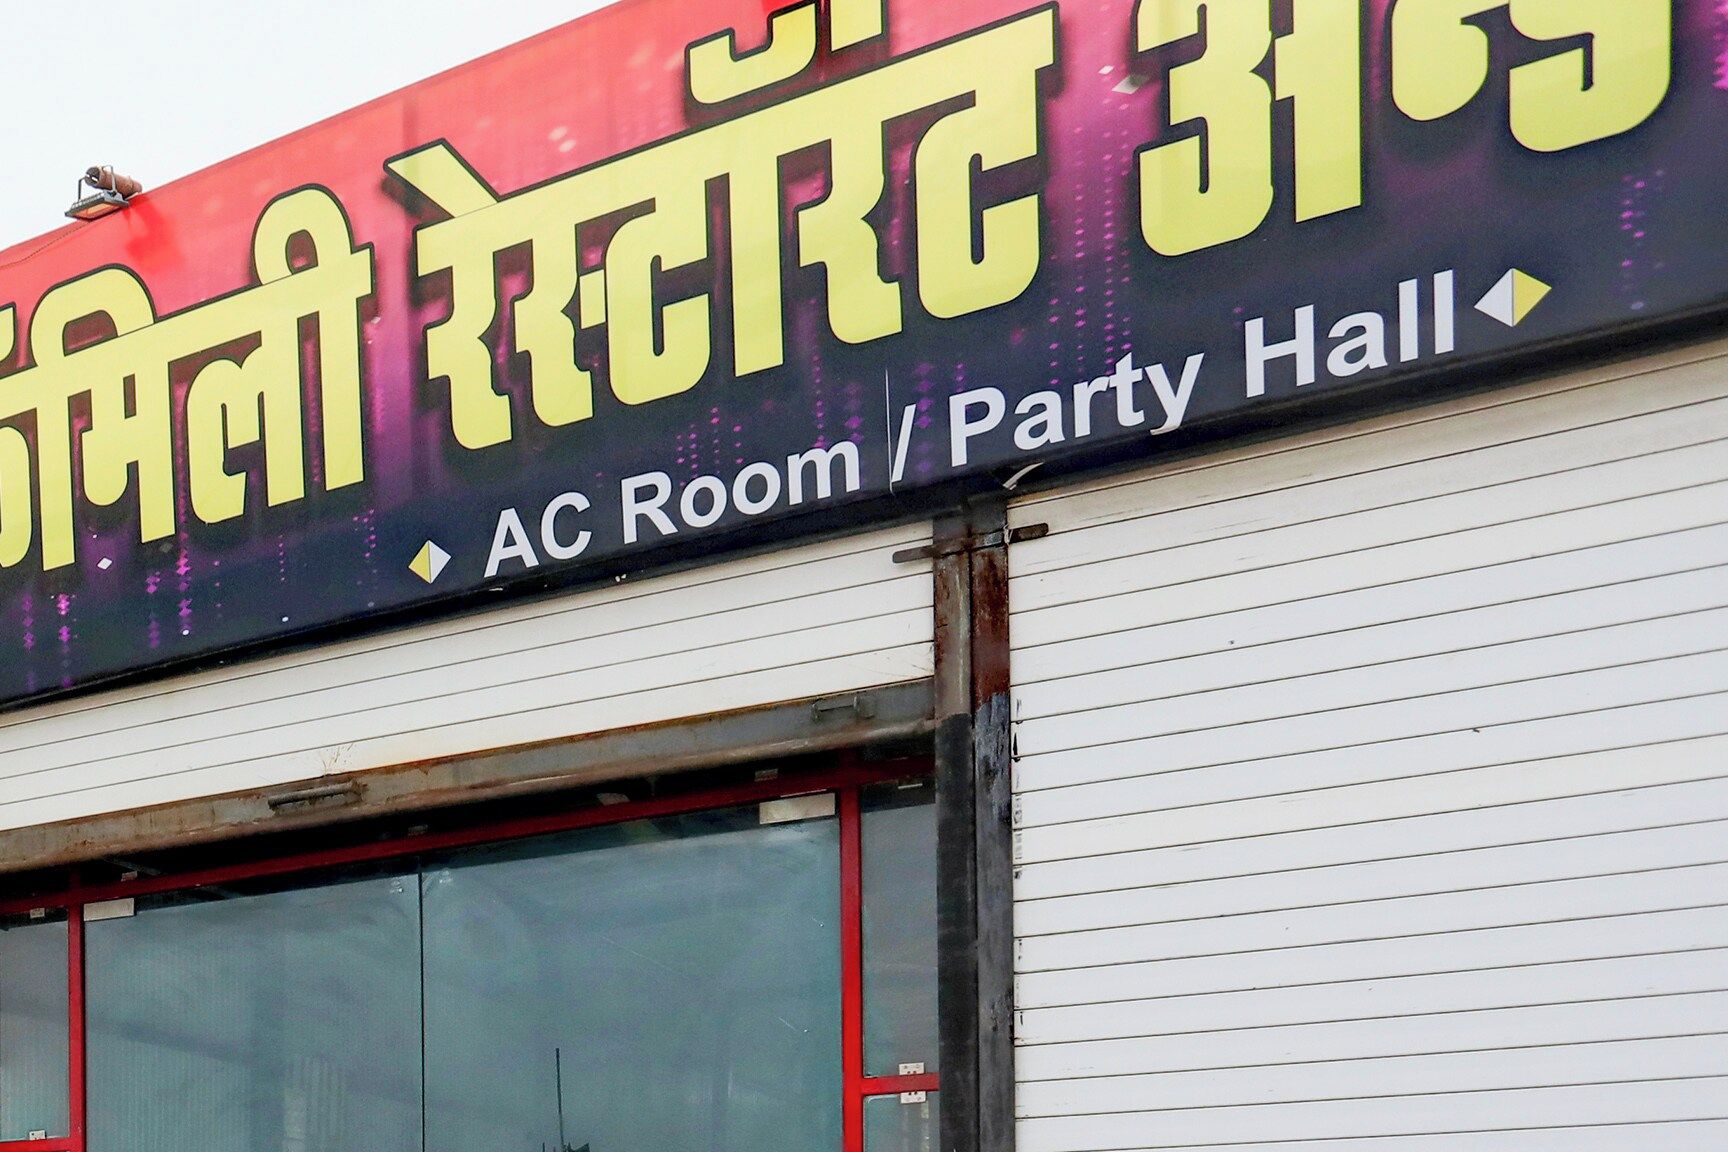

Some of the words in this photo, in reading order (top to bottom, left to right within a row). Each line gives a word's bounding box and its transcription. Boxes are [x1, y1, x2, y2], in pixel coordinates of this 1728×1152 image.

[483, 491, 592, 578] AC
[621, 440, 861, 545] Room
[948, 352, 1205, 468] Party
[1244, 268, 1455, 398] Hall
